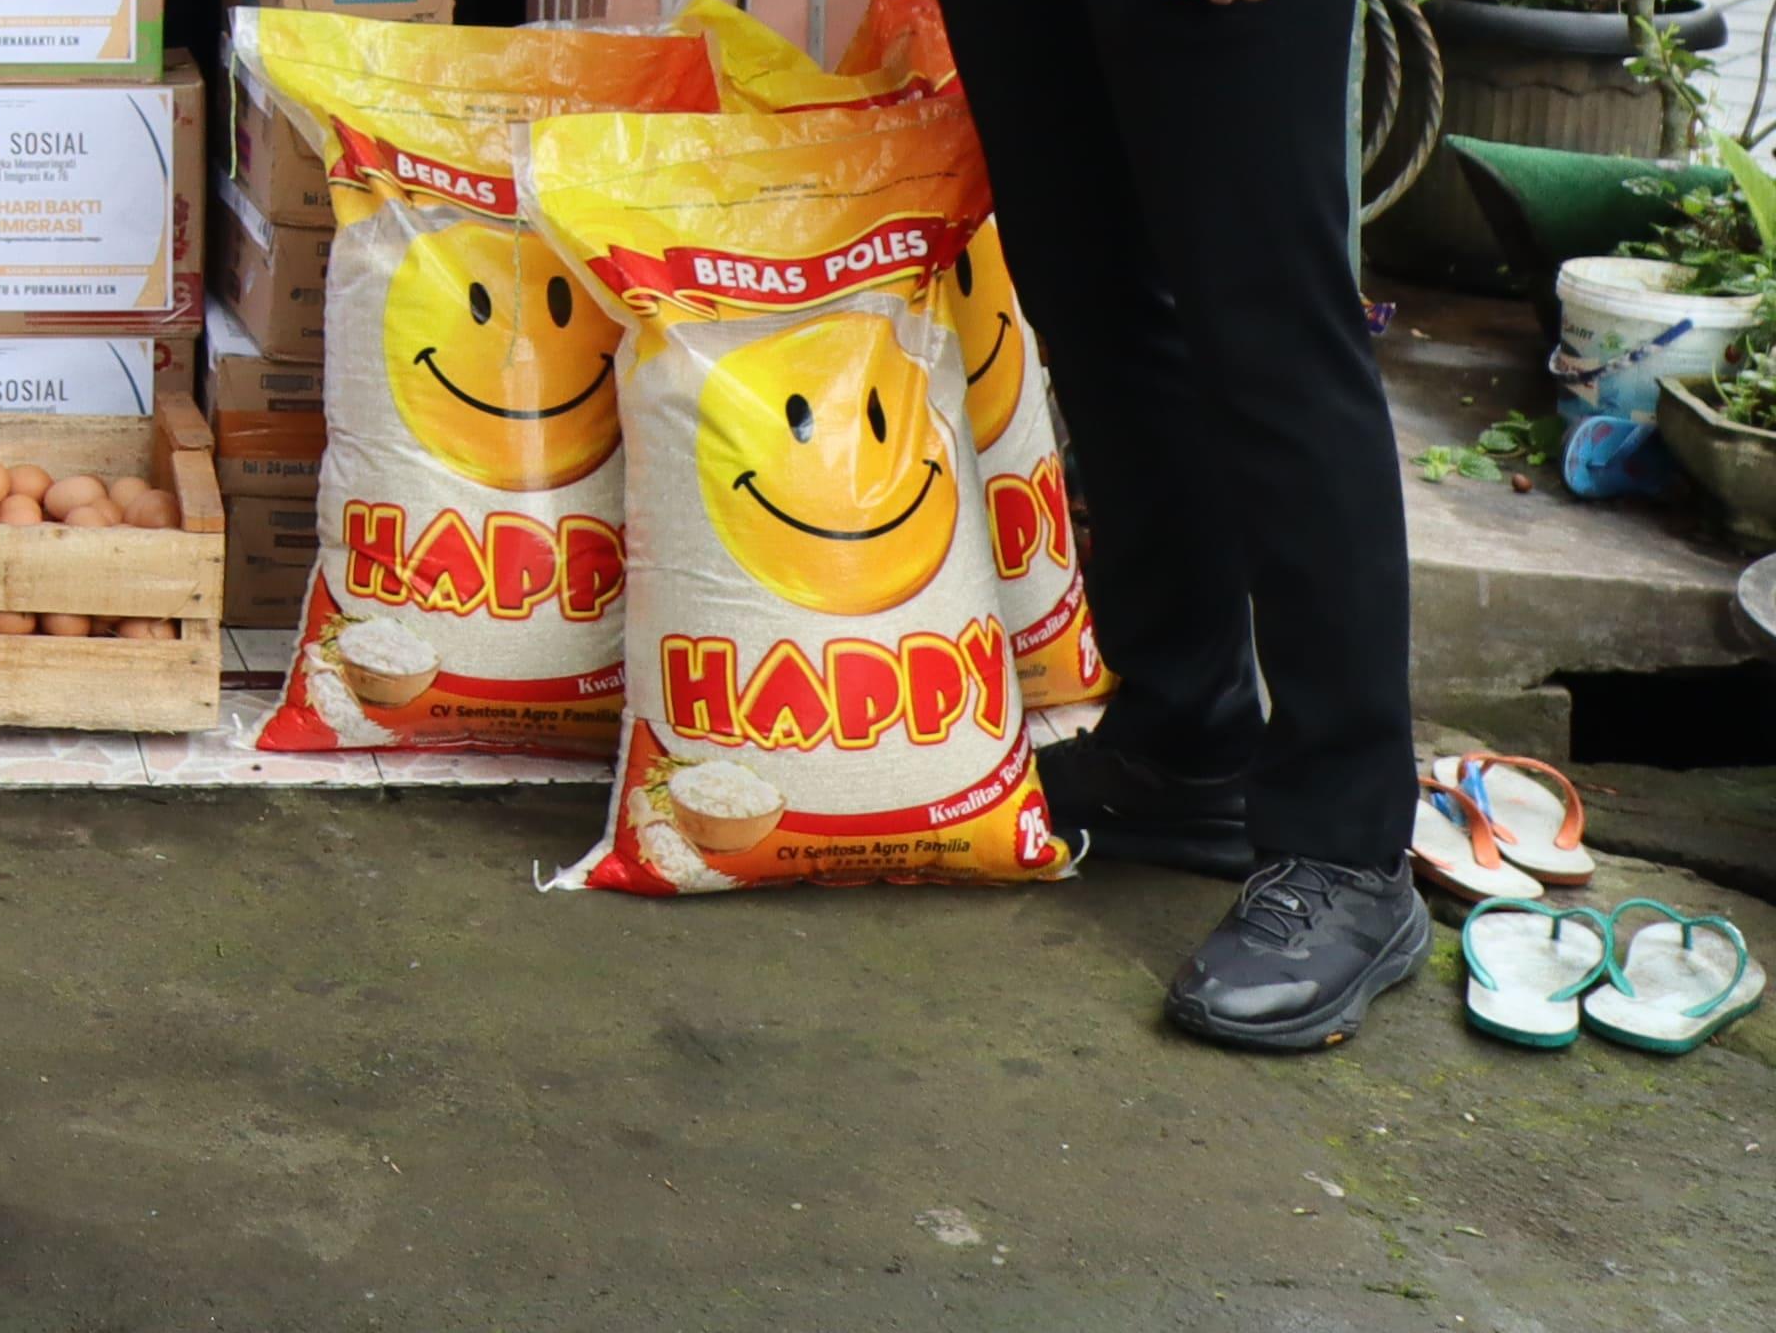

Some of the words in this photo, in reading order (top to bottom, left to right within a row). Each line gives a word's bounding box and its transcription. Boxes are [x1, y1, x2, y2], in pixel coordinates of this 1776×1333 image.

[59, 36, 80, 47] ASN
[10, 132, 88, 155] SOSIAL
[397, 153, 496, 205] BERAS
[46, 199, 102, 214] BAKTI
[694, 257, 807, 294] BERAS
[824, 230, 928, 282] POLES
[24, 284, 92, 296] PURNABAKTI
[96, 284, 116, 296] ASN
[343, 500, 624, 619] HAPP
[1015, 607, 1071, 653] Kwalitas
[661, 617, 1008, 751] HAPPY
[430, 704, 451, 718] CV
[456, 705, 517, 719] Sentosa
[522, 707, 558, 722] Agro
[563, 708, 621, 722] Familia
[928, 780, 1003, 826] Kwalitas
[777, 845, 799, 861] CV
[804, 843, 867, 859] Sentosa
[871, 841, 909, 858] Agro
[915, 837, 970, 853] Familia
